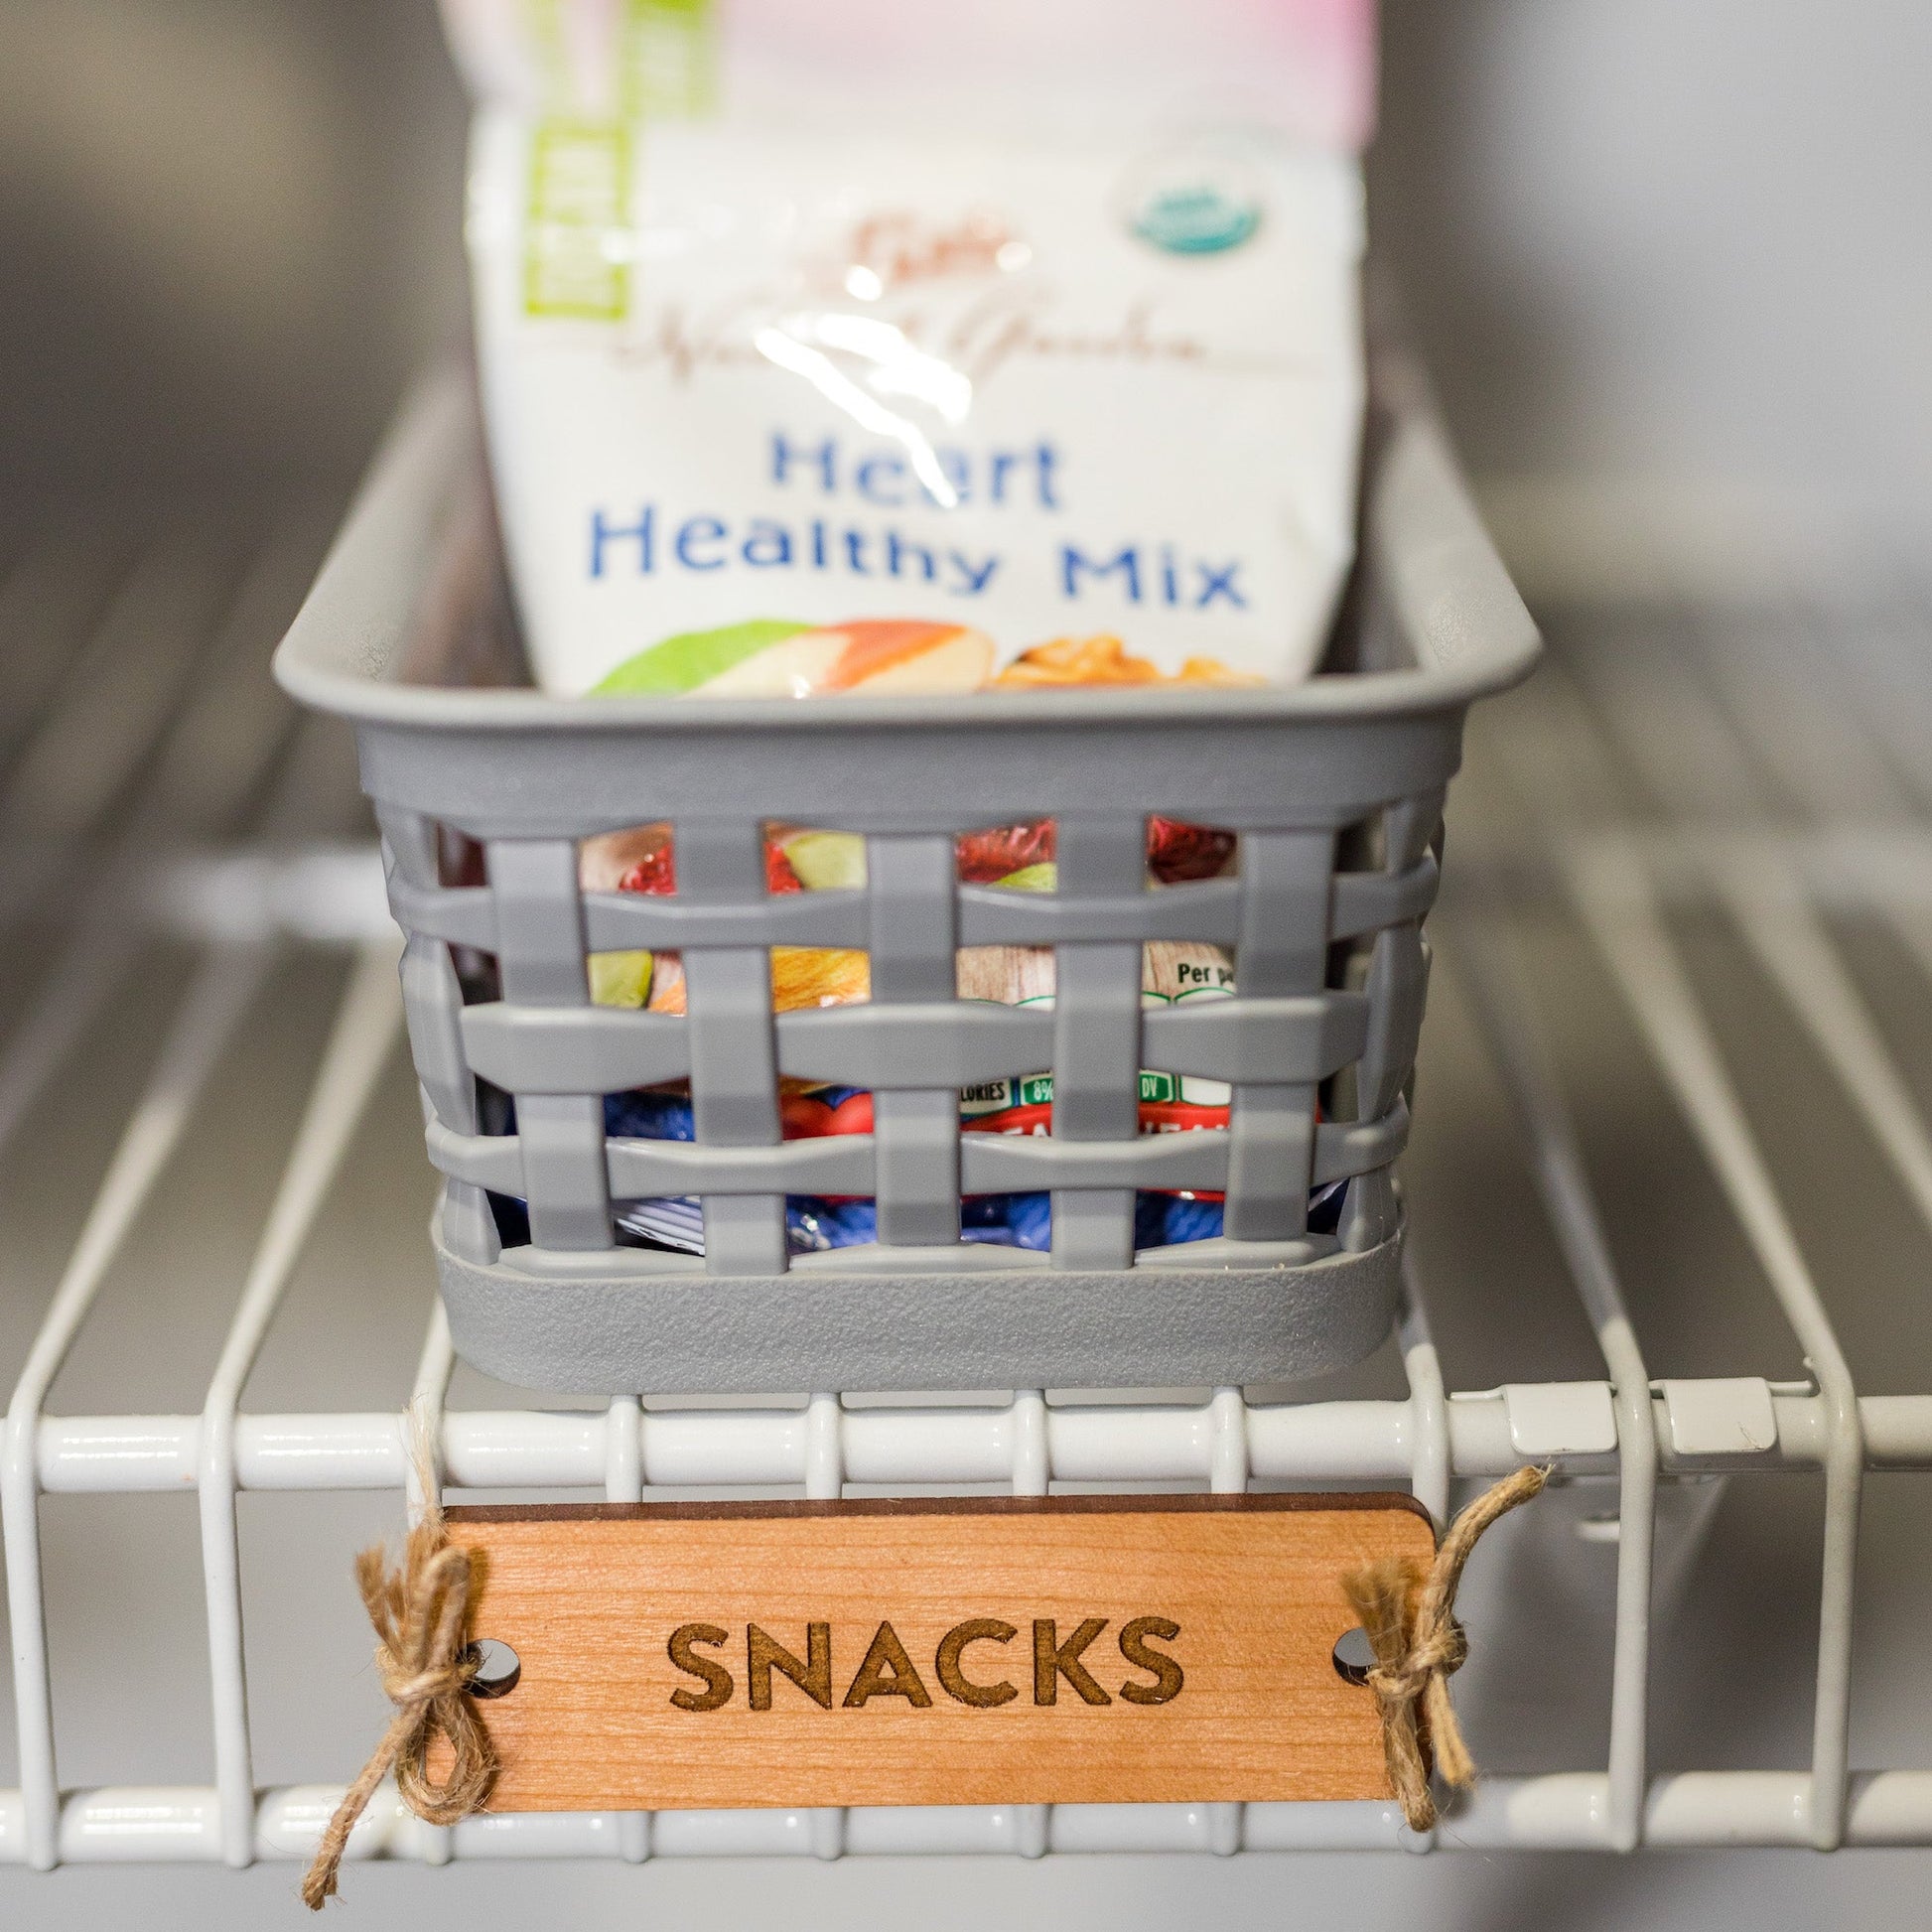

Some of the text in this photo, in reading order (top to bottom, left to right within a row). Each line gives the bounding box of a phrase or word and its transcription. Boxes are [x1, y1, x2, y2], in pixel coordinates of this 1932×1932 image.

[768, 431, 1064, 510] Heart
[589, 502, 1251, 612] Healthy Mix
[1177, 962, 1210, 984] Per
[959, 1081, 1005, 1102] LORIES
[1141, 1077, 1158, 1098] DV
[666, 1615, 1185, 1712] SNACKS
